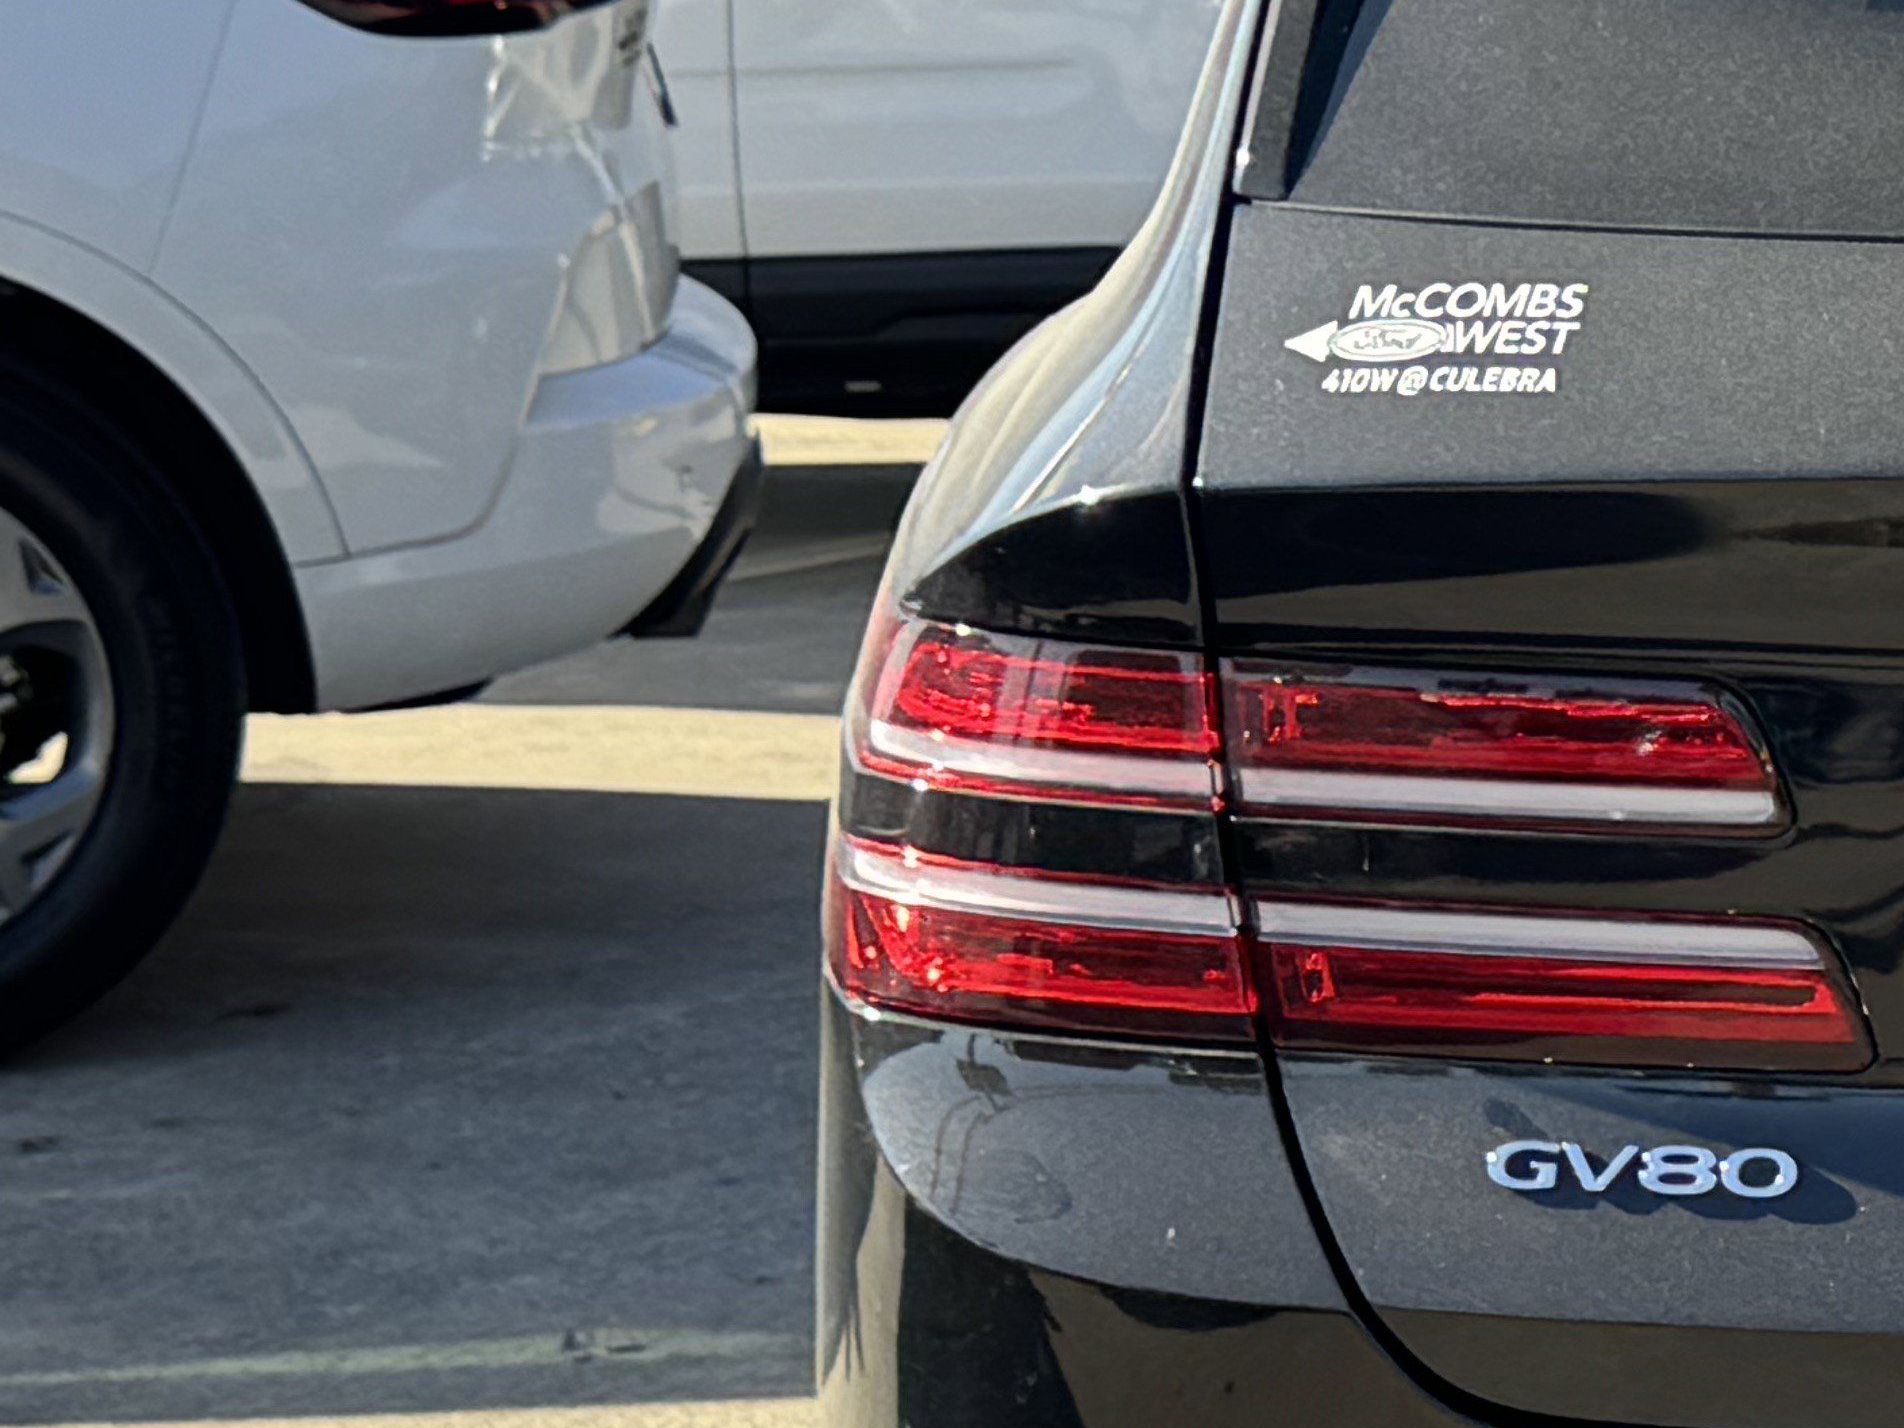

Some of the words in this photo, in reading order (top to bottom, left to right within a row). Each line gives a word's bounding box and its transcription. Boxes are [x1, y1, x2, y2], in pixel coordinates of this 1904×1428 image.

[1349, 283, 1589, 319] McCOMBS
[1454, 321, 1581, 355] WEST
[1486, 1139, 1798, 1199] GV80
